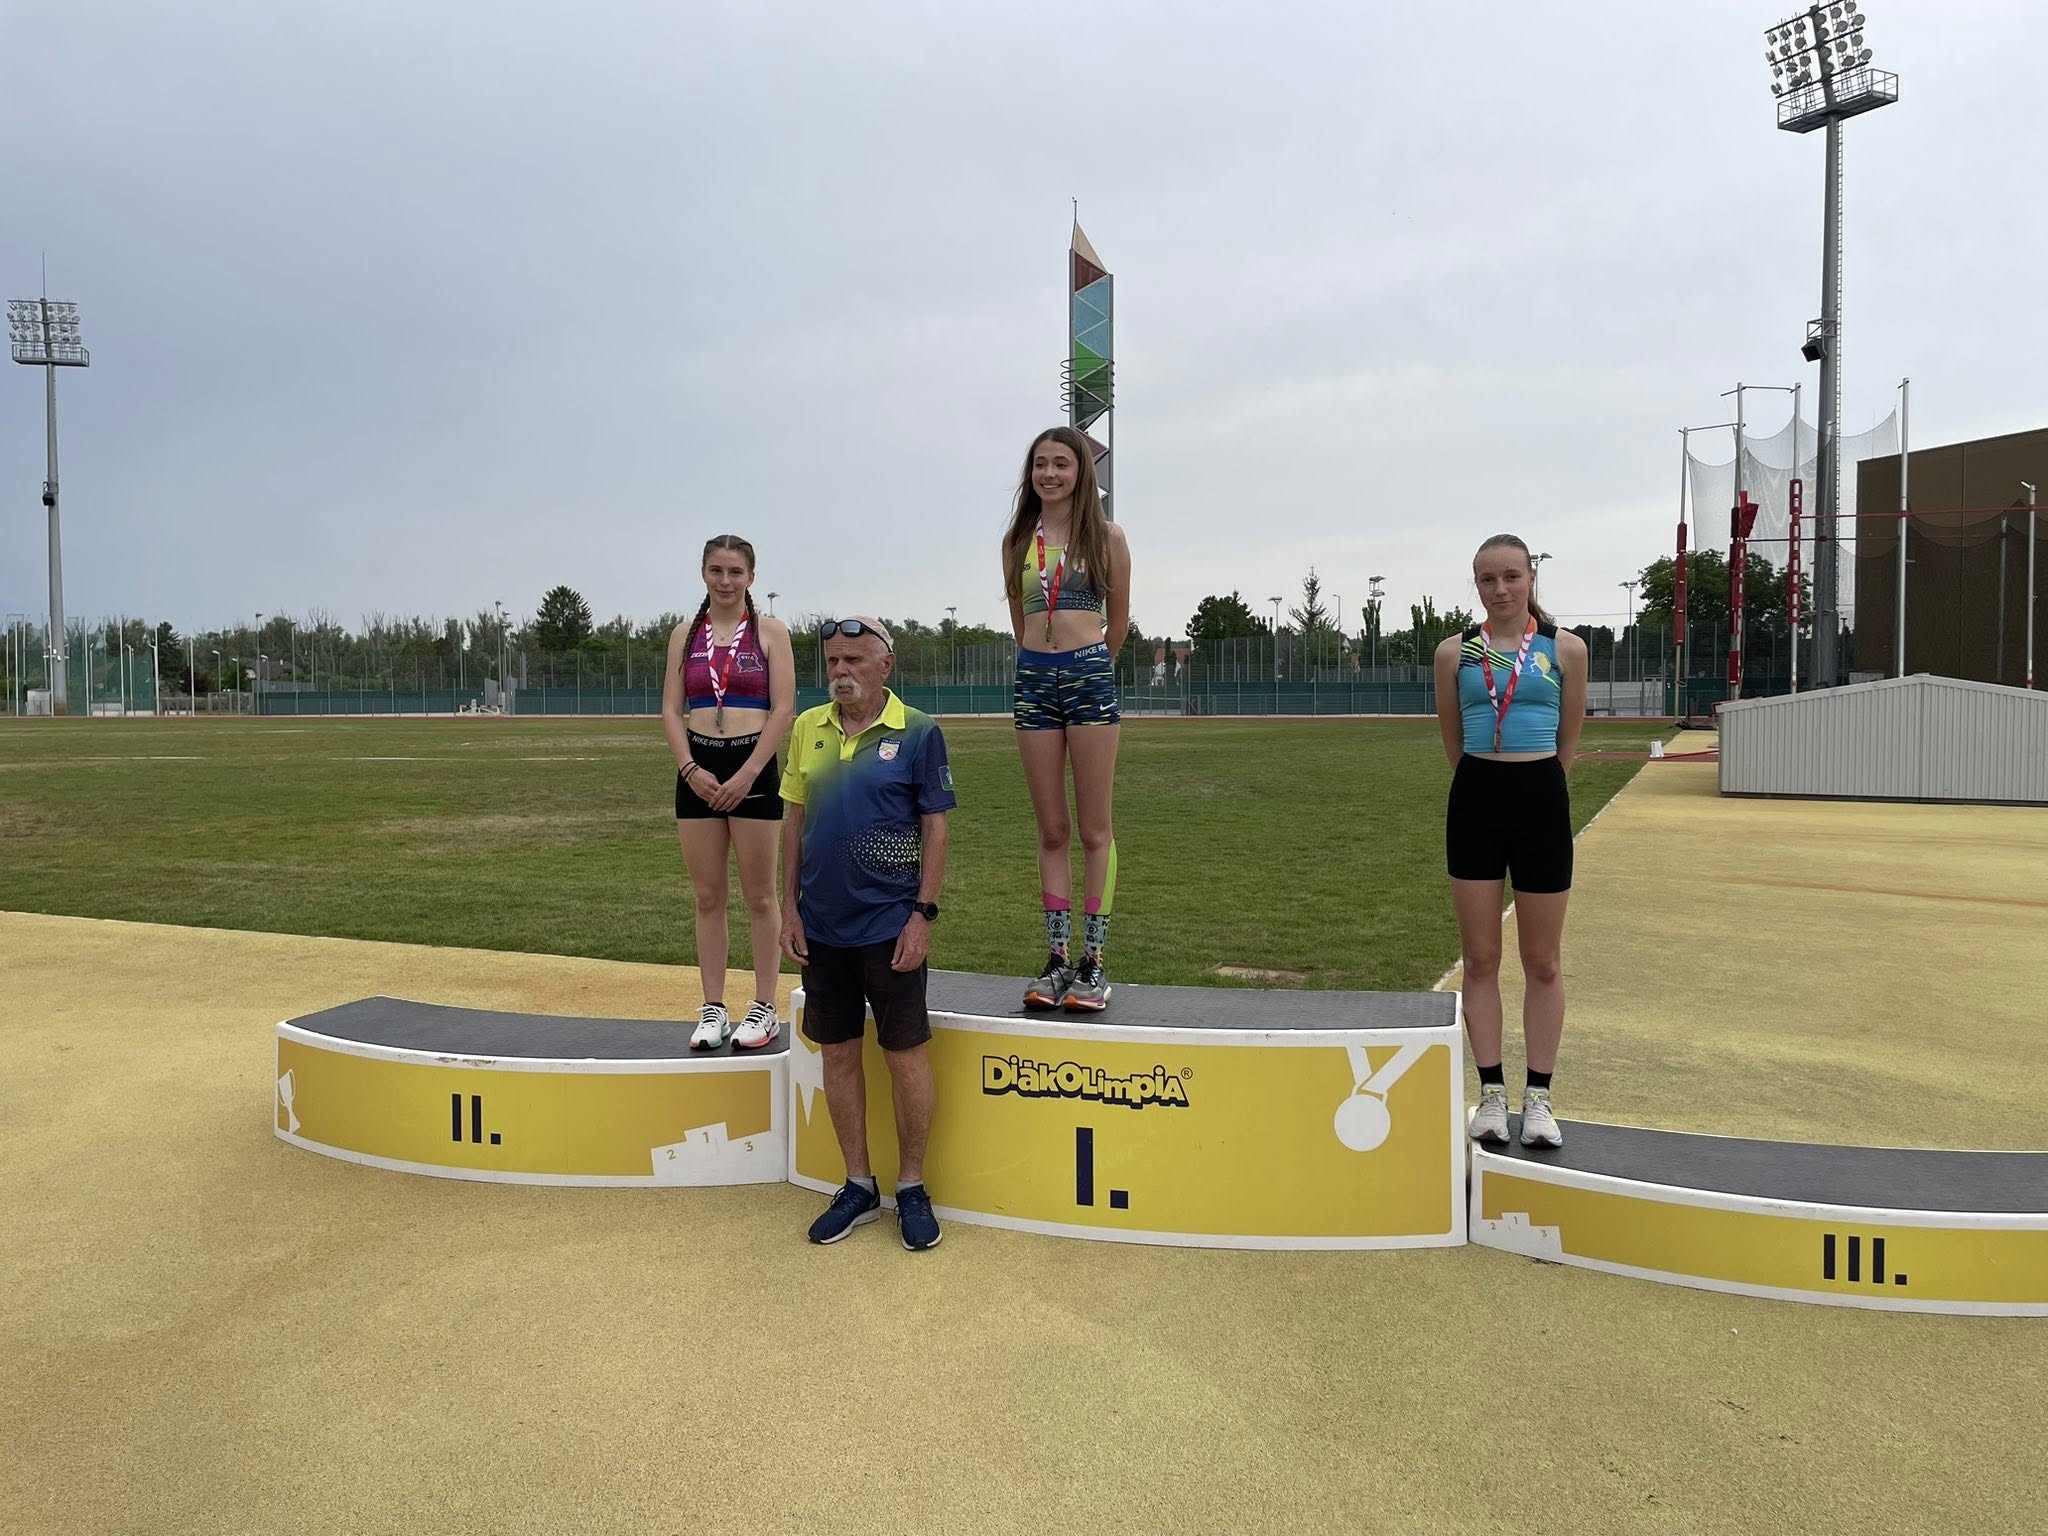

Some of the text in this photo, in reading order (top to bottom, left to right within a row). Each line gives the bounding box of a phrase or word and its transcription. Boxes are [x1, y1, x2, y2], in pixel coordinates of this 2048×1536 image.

[1074, 645, 1097, 659] NIKE
[692, 735, 725, 748] NIKE PRO
[730, 736, 751, 747] NIKE
[451, 1092, 502, 1146] II.
[666, 1131, 754, 1161] 2 1 3
[1075, 1126, 1129, 1210] I.
[1489, 1215, 1548, 1238] 2 1 3
[1823, 1233, 1908, 1286] III.
